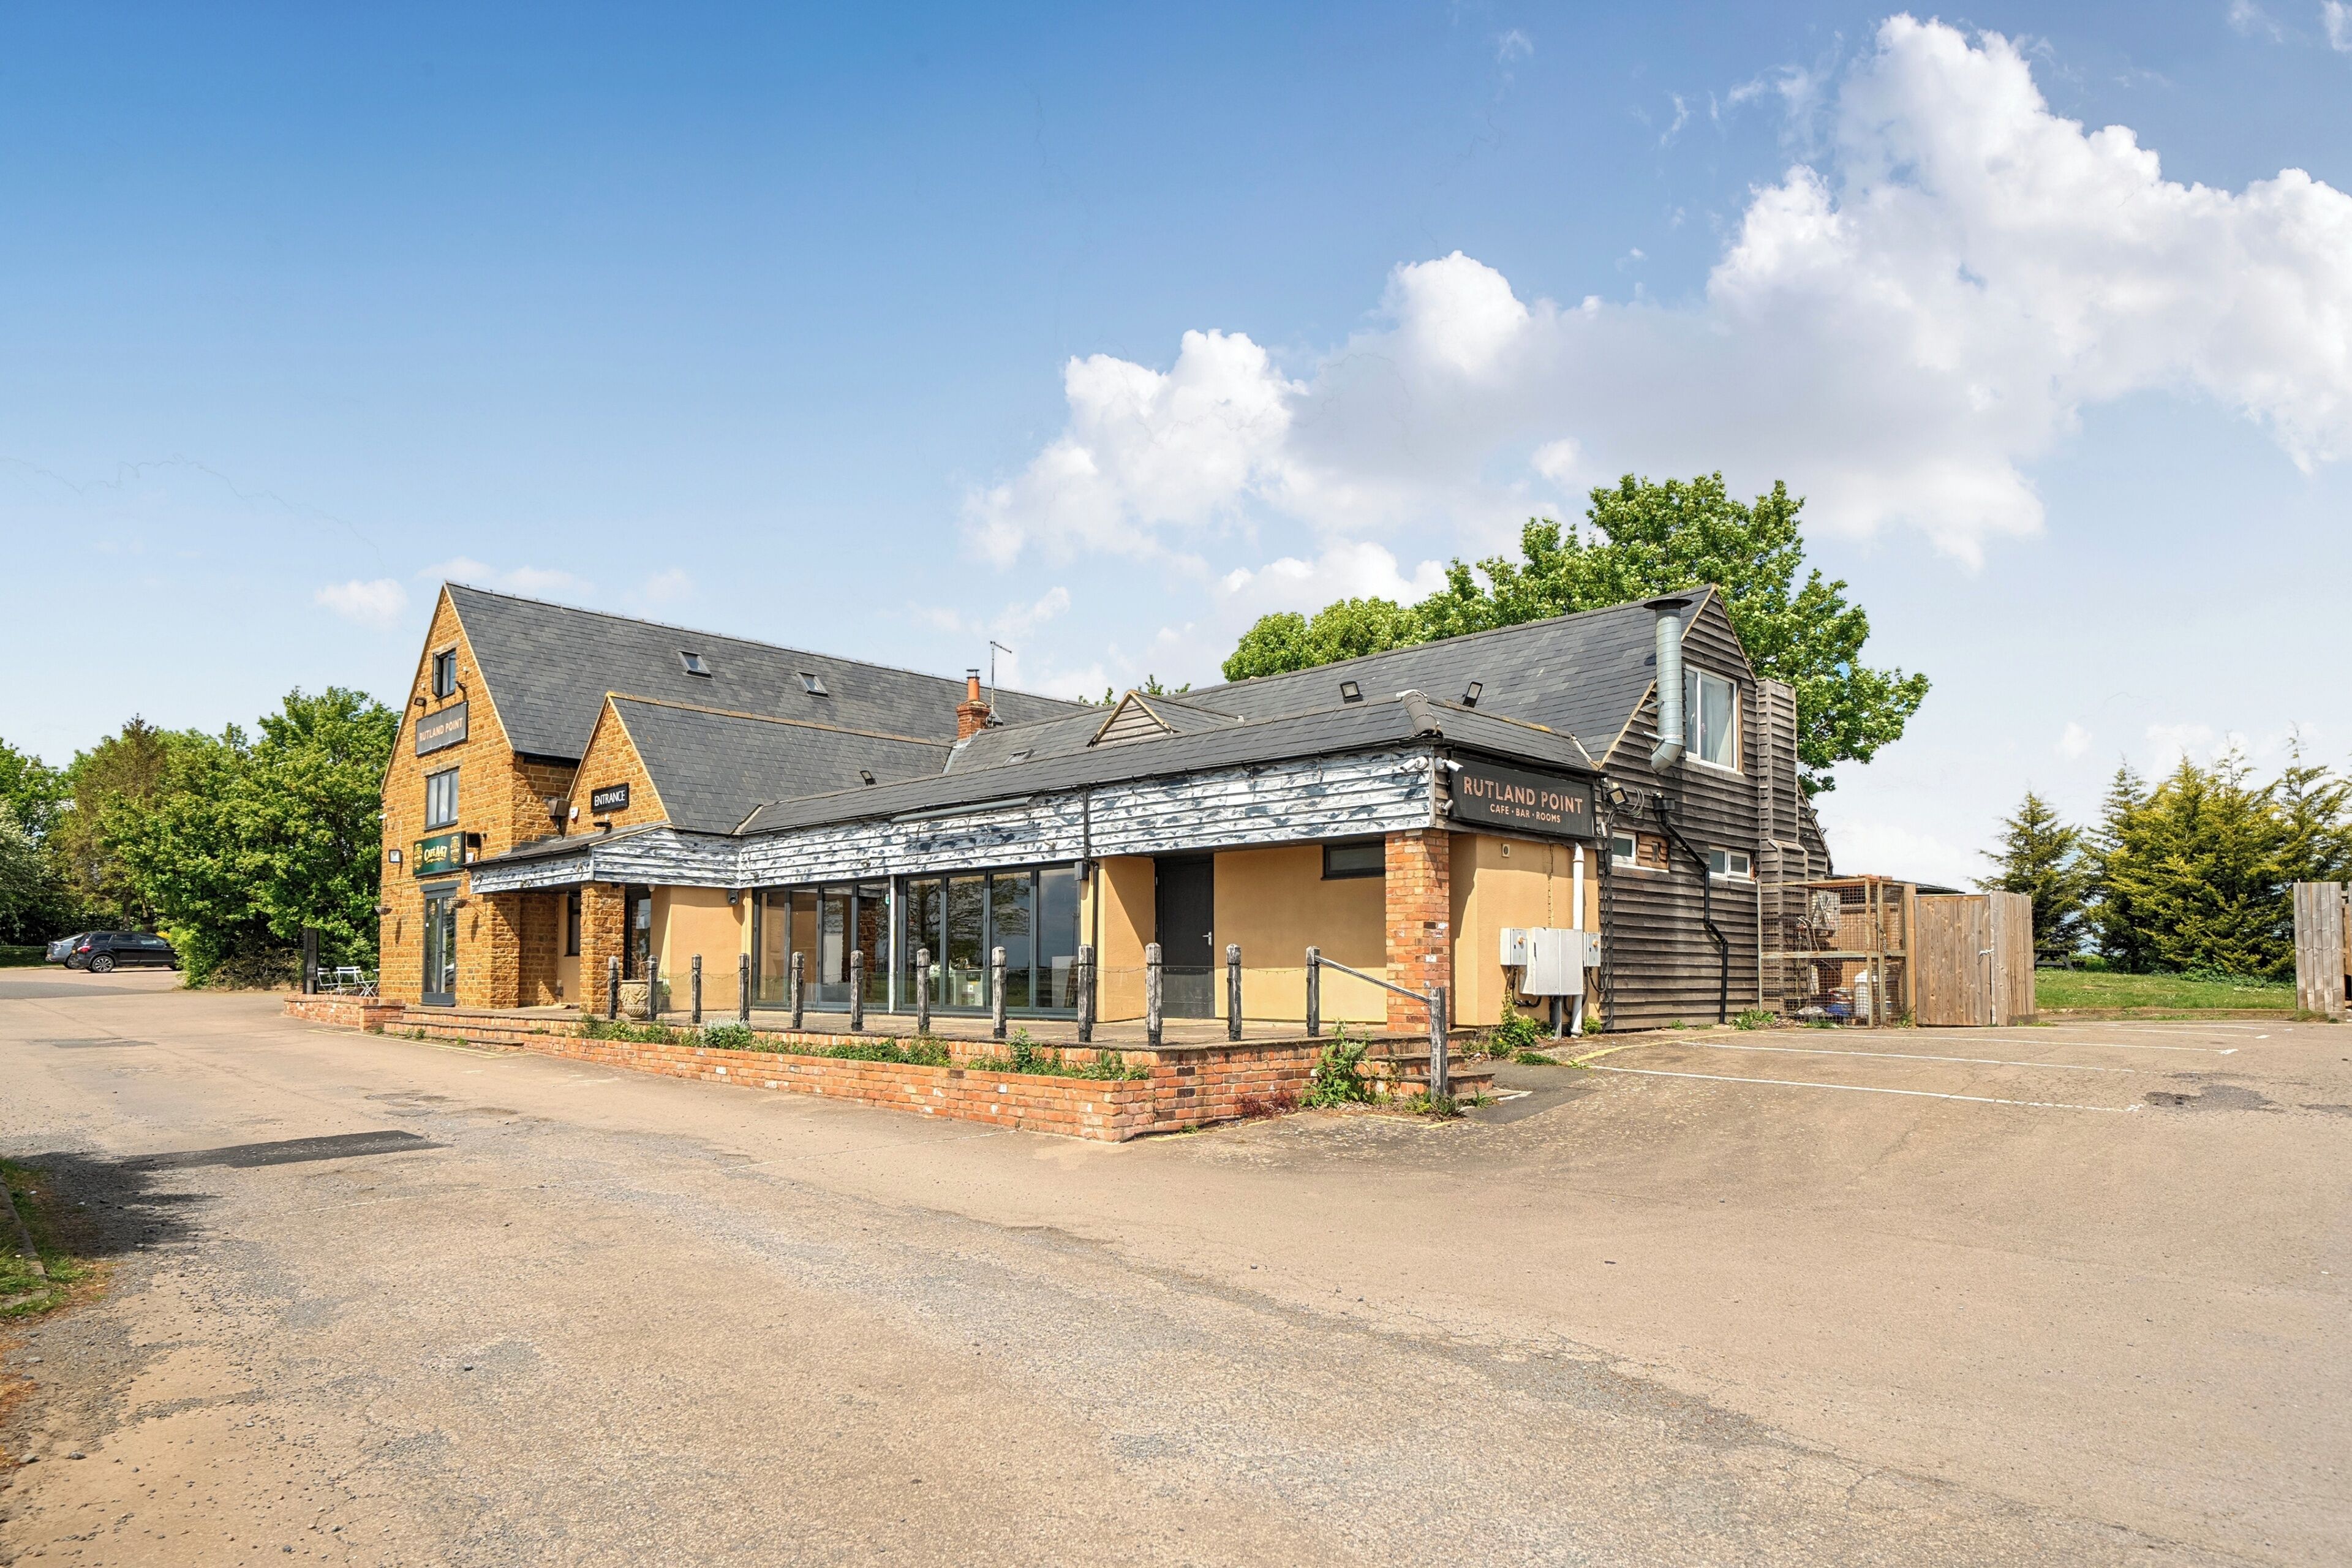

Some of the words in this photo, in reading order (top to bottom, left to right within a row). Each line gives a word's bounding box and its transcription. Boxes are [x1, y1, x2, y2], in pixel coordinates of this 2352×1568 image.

[419, 725, 444, 742] RUTLAND
[445, 718, 463, 733] POINT
[594, 790, 625, 806] ENTRANCE
[1464, 777, 1536, 805] RUTLAND
[1541, 791, 1583, 814] POINT
[1490, 804, 1509, 815] CAFE
[1515, 808, 1530, 818] BAR
[1536, 812, 1561, 823] ROOMS
